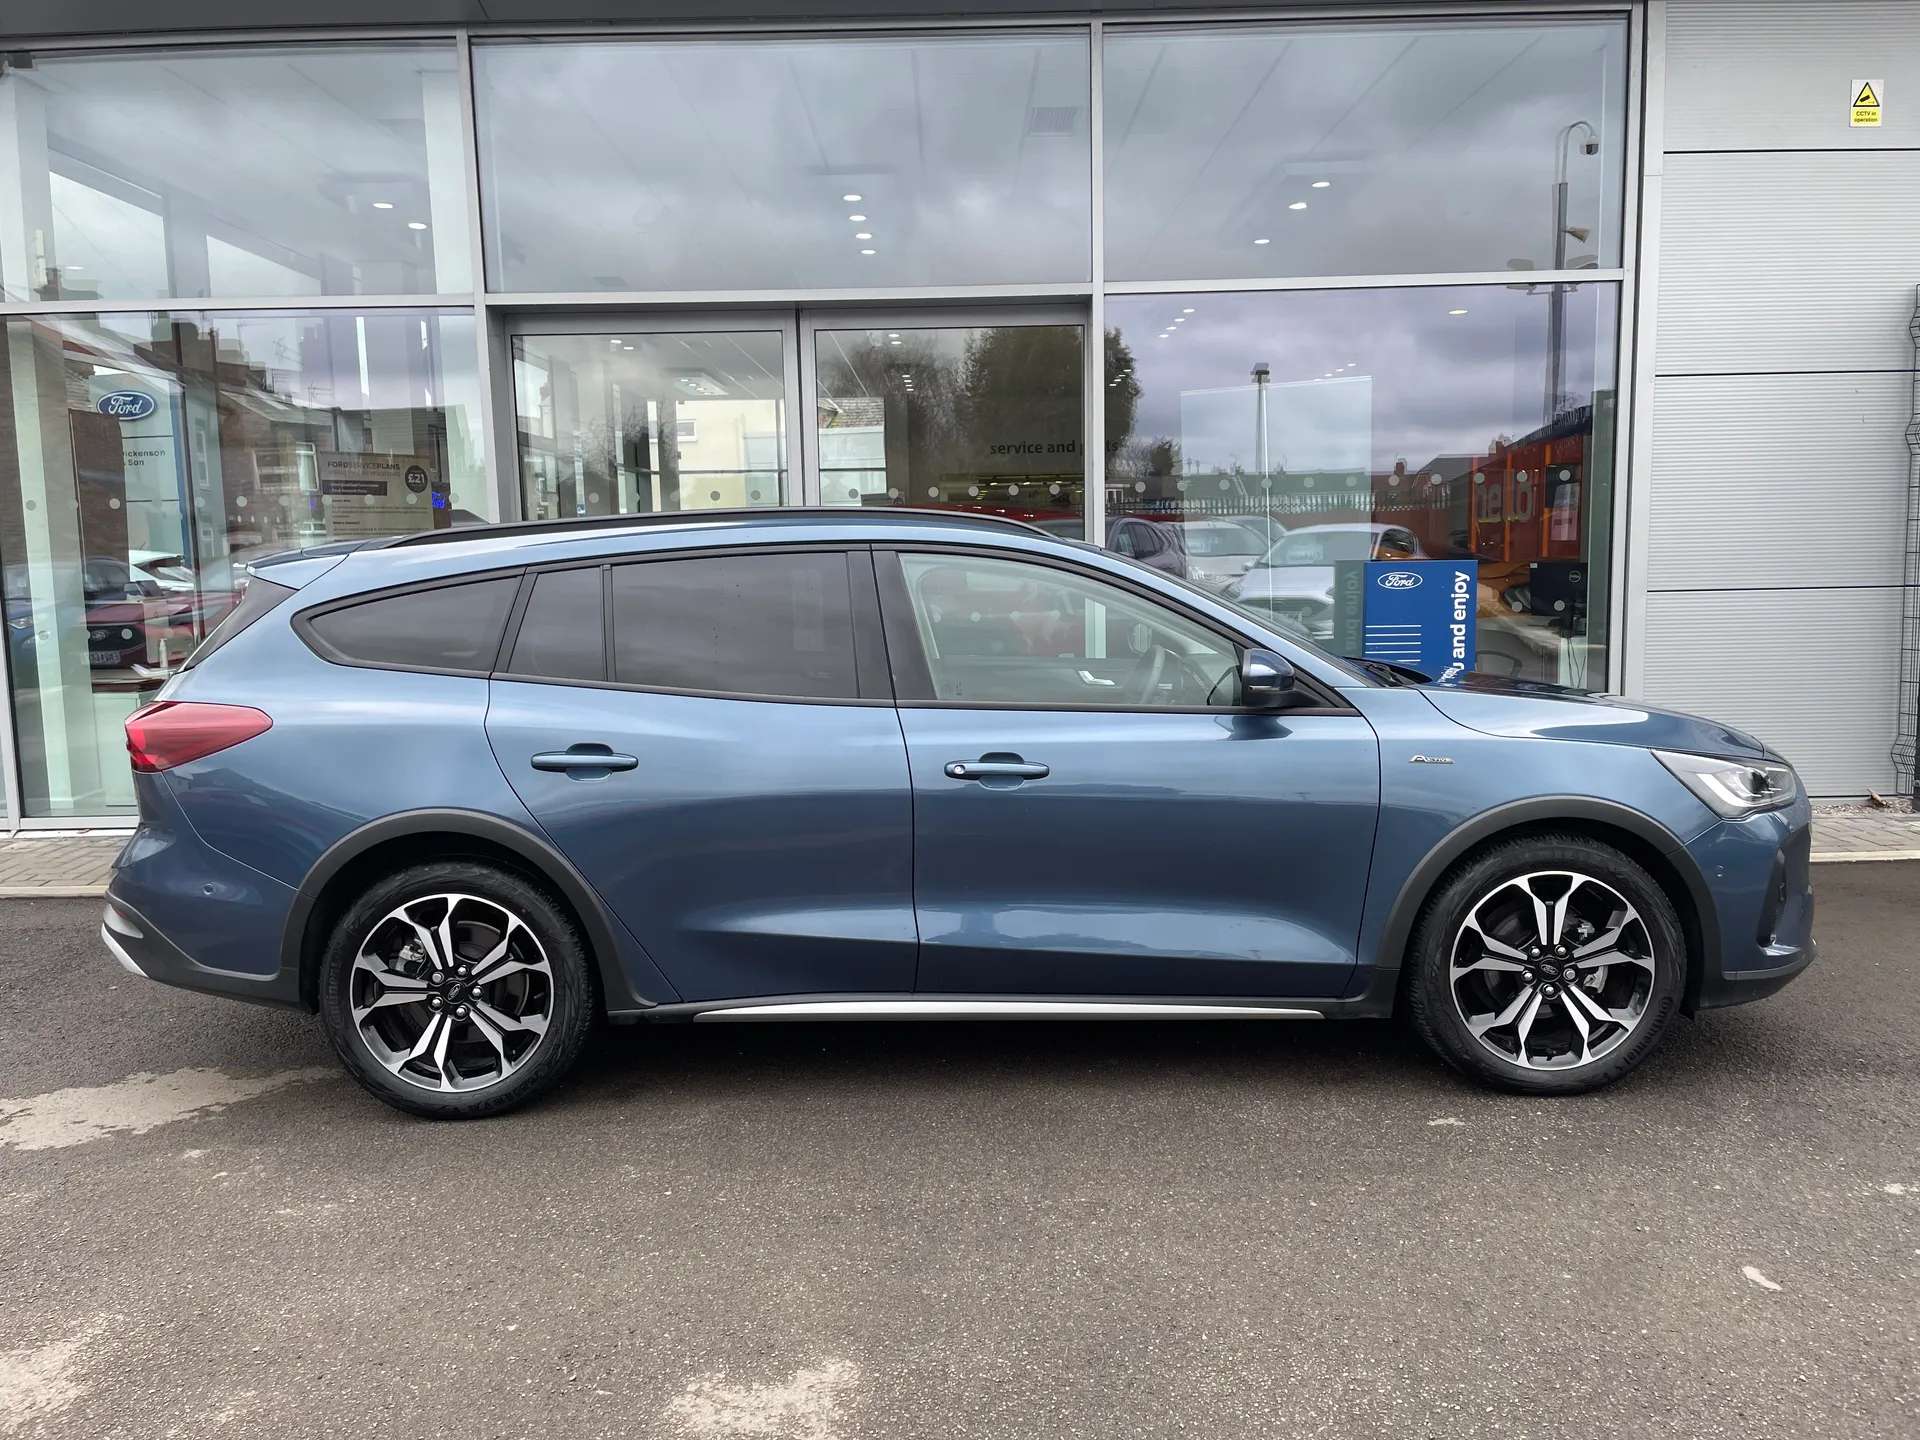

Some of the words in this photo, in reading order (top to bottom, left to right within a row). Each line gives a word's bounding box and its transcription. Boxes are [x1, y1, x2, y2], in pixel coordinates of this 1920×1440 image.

[108, 395, 142, 414] Ford
[122, 449, 165, 457] ickenson
[990, 441, 1042, 454] service
[1047, 440, 1075, 453] and
[408, 473, 425, 483] £21
[1384, 574, 1415, 587] Ford
[1451, 571, 1470, 620] enjoy
[1450, 624, 1465, 659] and
